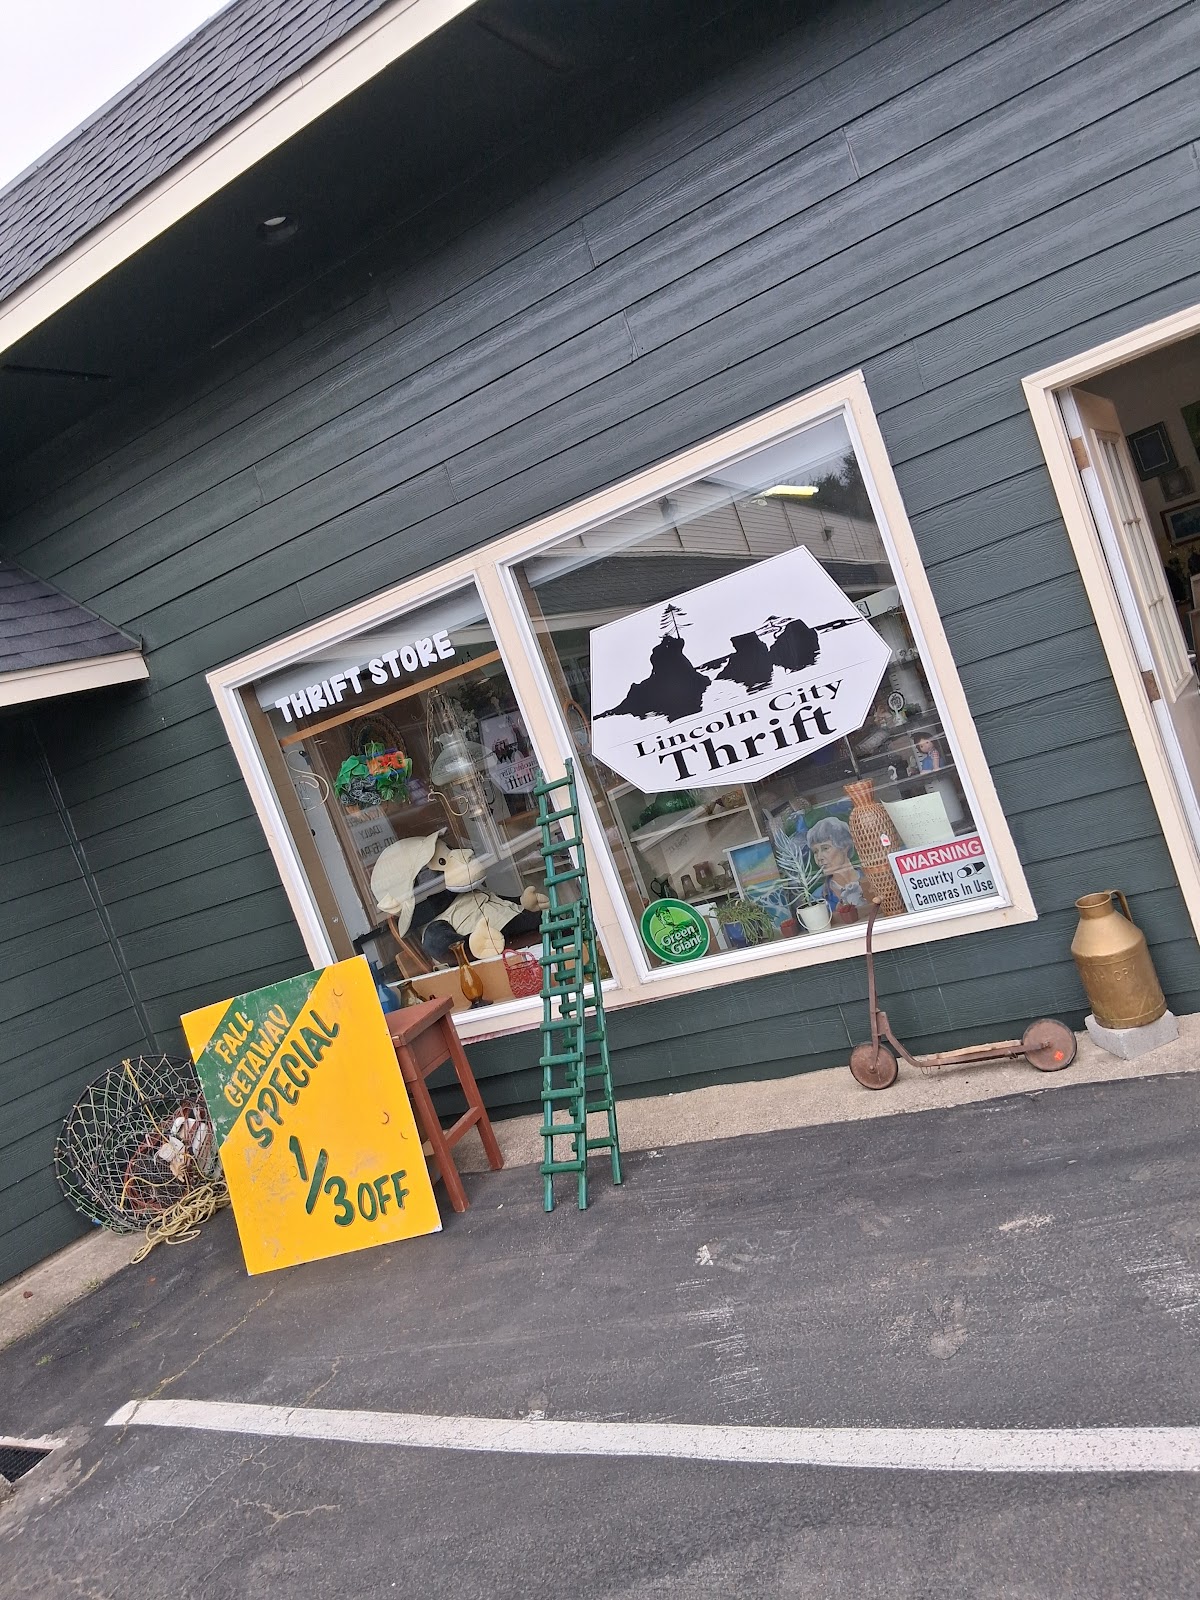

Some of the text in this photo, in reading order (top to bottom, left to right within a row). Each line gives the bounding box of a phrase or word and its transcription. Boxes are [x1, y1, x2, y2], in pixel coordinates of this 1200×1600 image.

[274, 629, 456, 723] THRIFT STORE
[633, 708, 760, 758] Lincoln
[768, 679, 844, 712] City
[658, 705, 838, 782] Thrift
[900, 840, 983, 872] WARNING
[909, 870, 955, 891] Security
[915, 879, 994, 906] Cameras In Use
[661, 925, 696, 947] Green
[670, 932, 702, 955] Giant
[214, 1011, 254, 1064] FALL
[223, 1003, 291, 1108] GETAWAY
[244, 1009, 341, 1150] SPECIAL
[289, 1135, 410, 1227] 1/3 OFF
